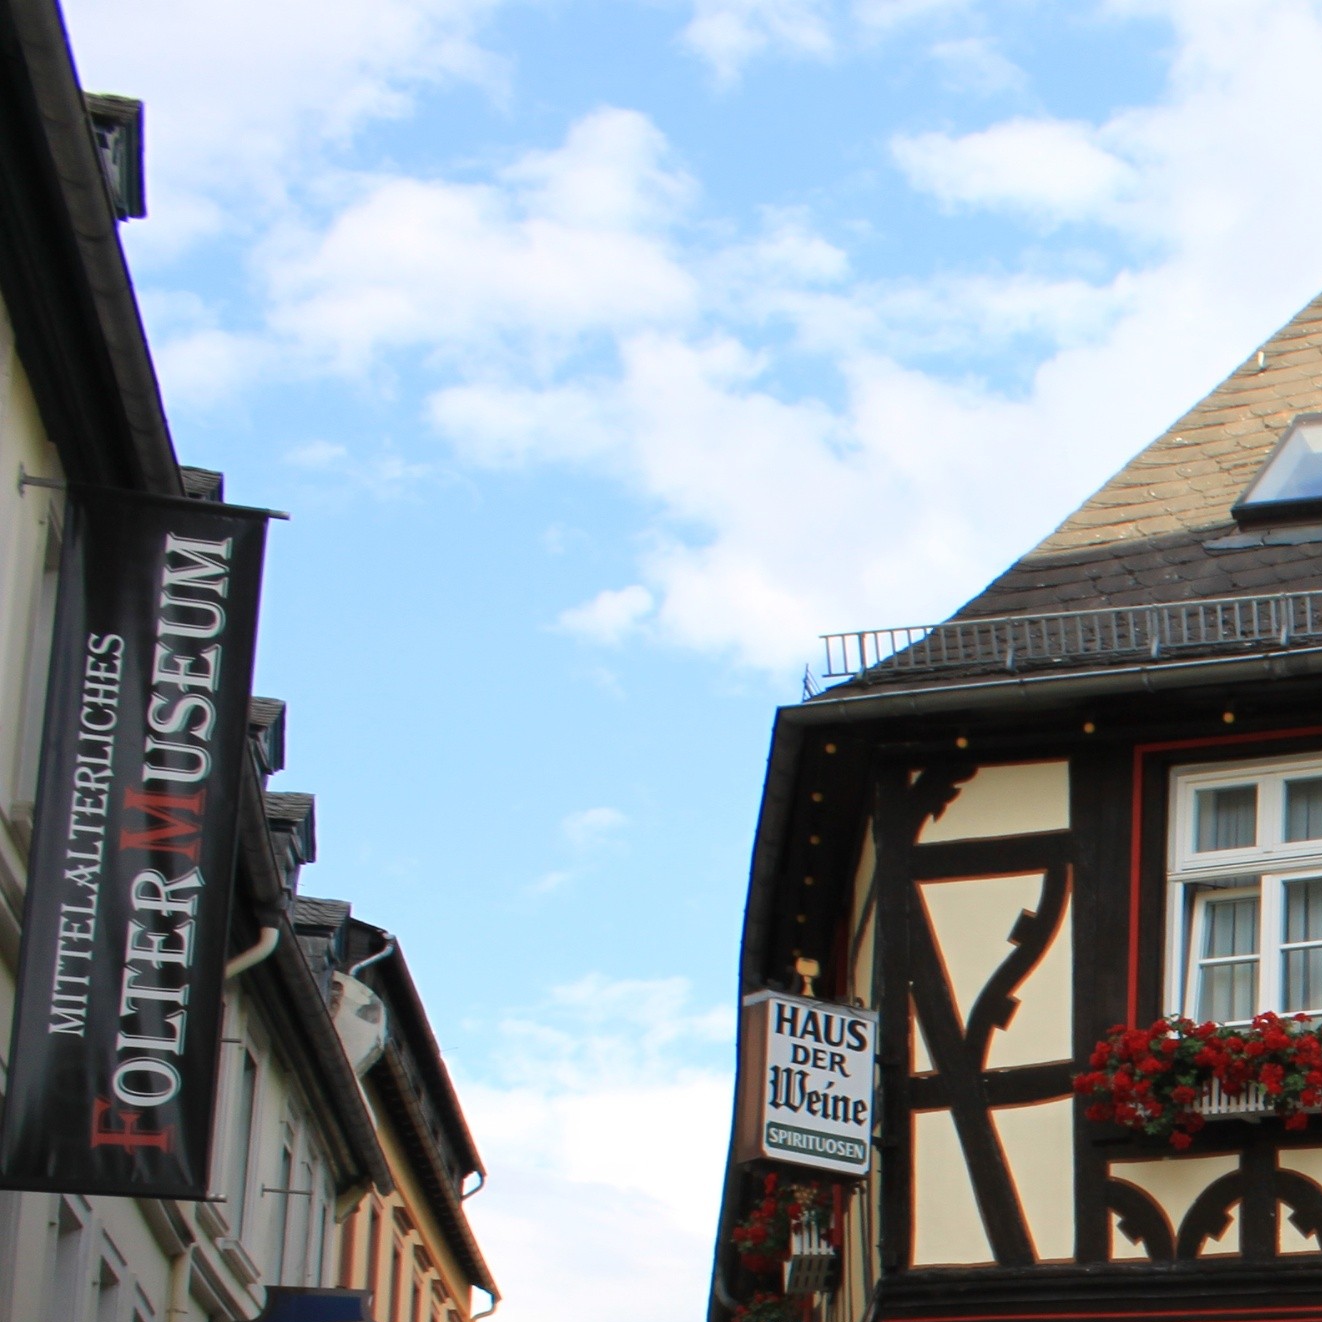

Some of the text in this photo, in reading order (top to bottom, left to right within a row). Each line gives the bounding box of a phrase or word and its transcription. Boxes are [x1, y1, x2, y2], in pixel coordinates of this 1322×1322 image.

[49, 632, 125, 1038] MITTELALTERLICHES
[90, 530, 234, 1154] FOLTER MUSEUM
[775, 1002, 868, 1052] HAUS
[791, 1043, 851, 1078] DER
[768, 1065, 868, 1127] Weine
[768, 1127, 865, 1160] SPIRITUOSEN
